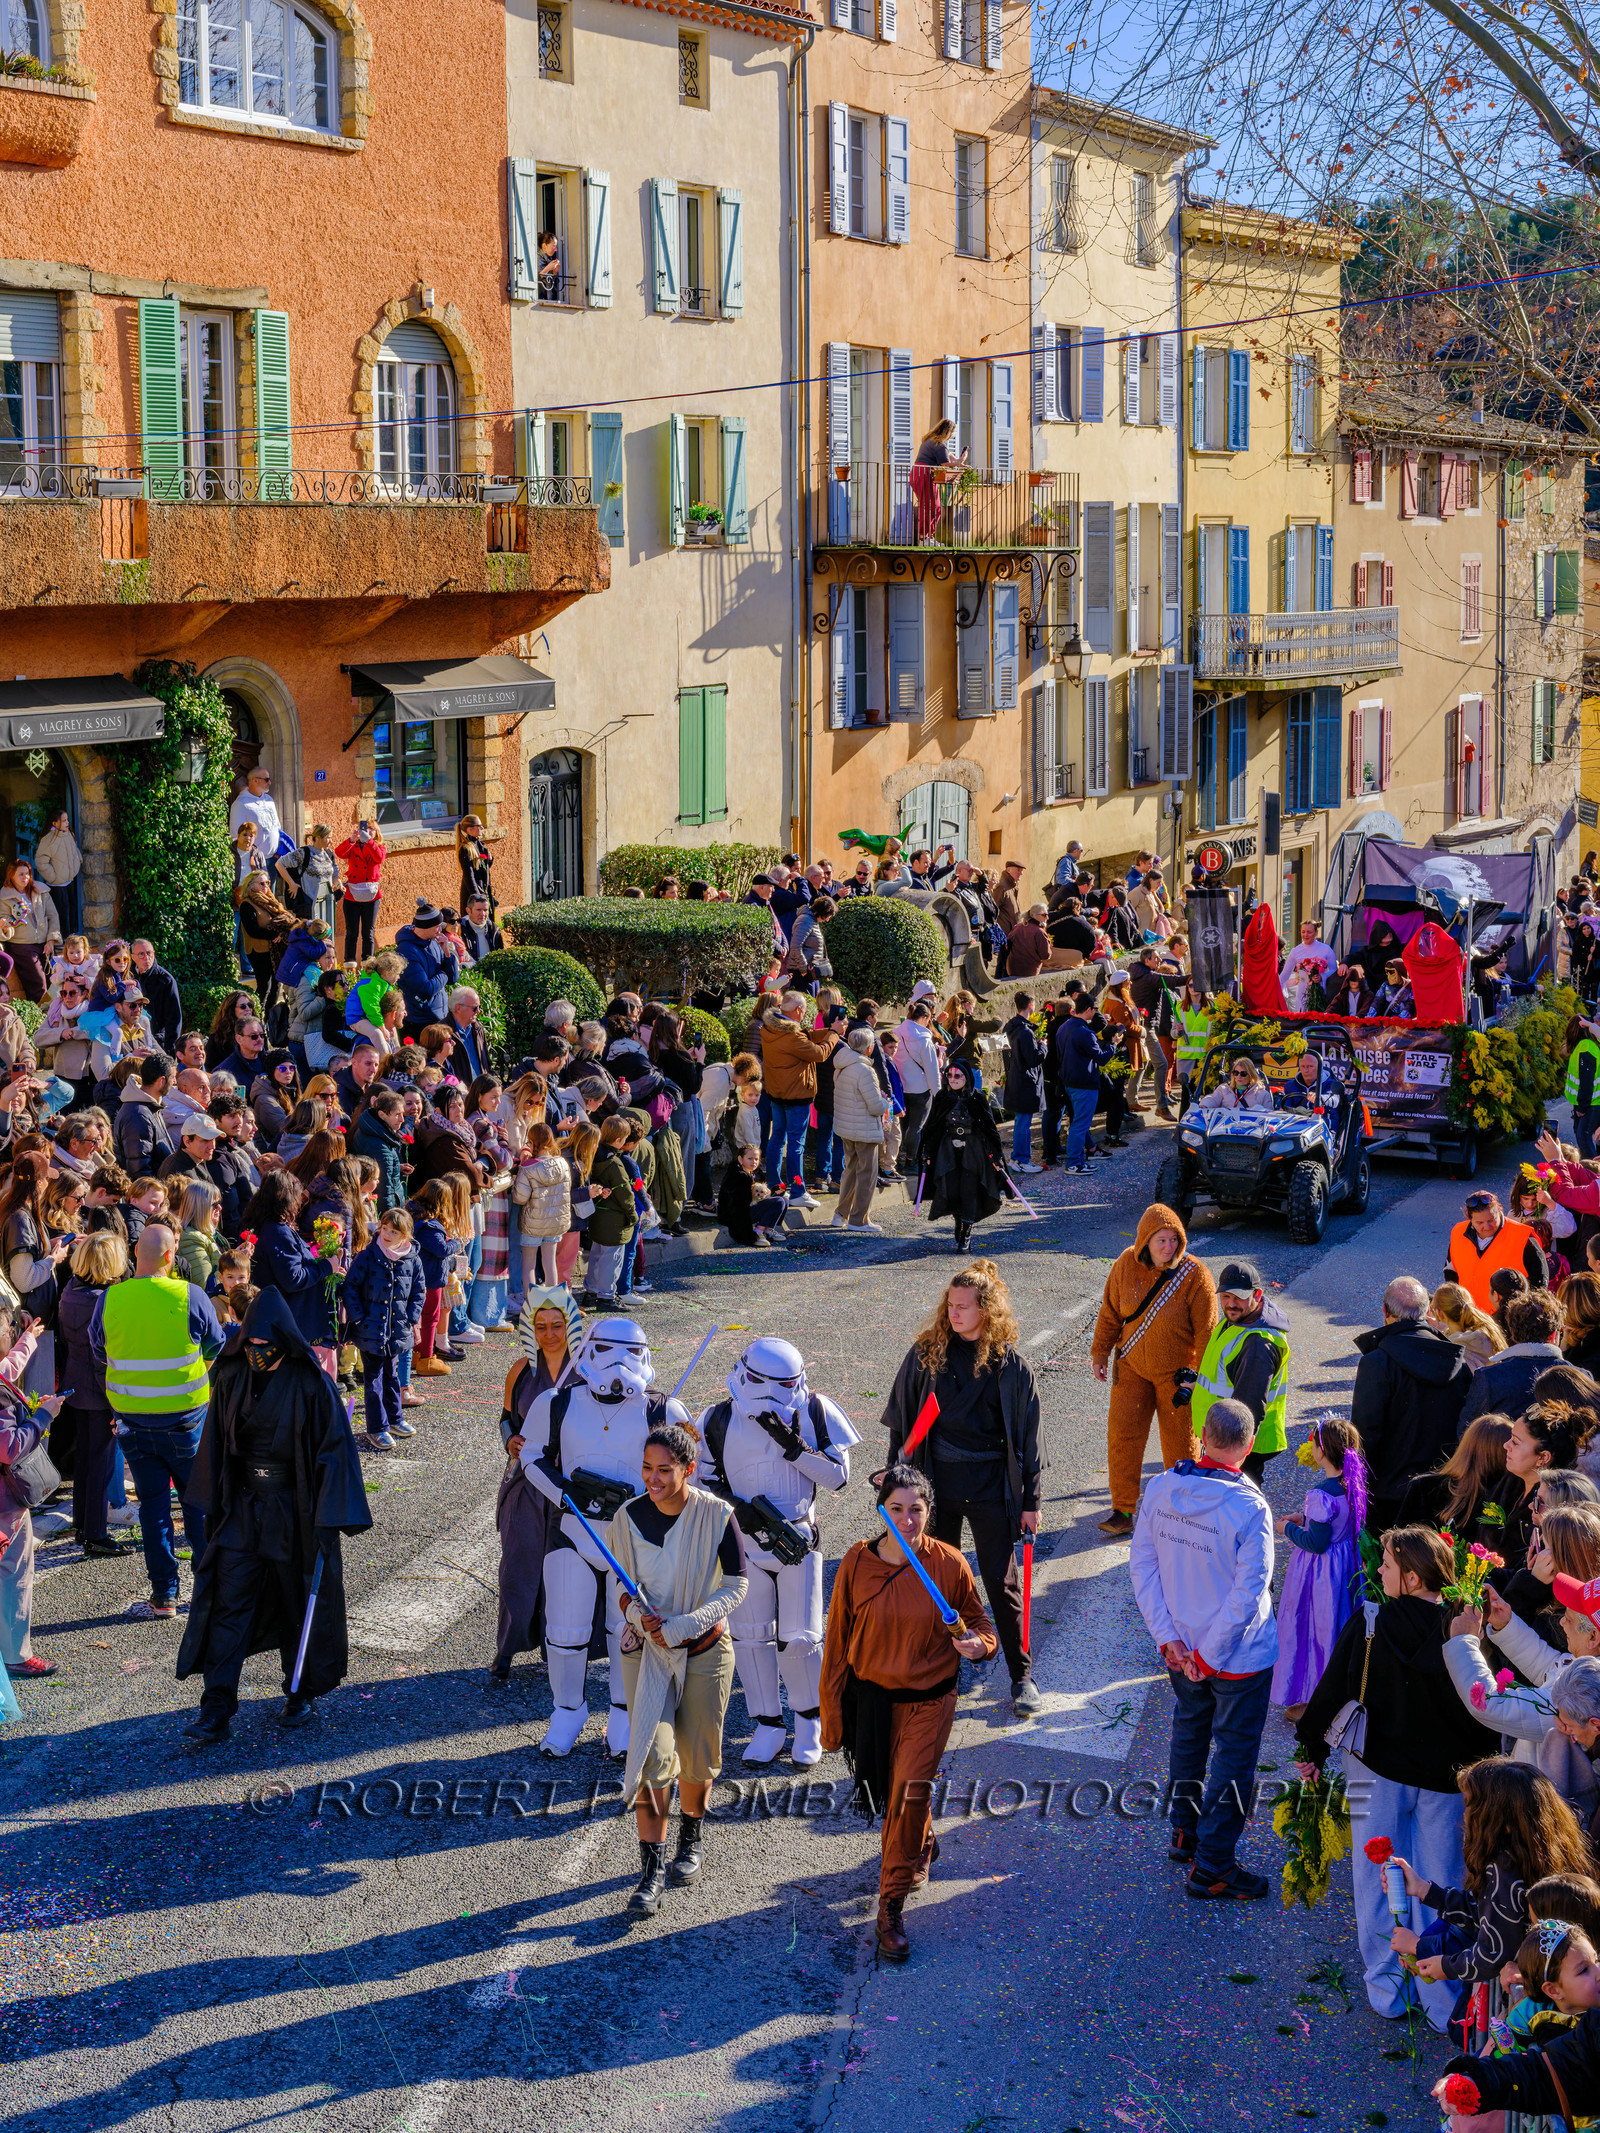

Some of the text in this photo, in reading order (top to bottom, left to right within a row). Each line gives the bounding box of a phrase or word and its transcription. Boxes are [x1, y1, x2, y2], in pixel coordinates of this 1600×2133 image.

[454, 691, 516, 705] MAGREY & SONS
[39, 716, 122, 733] MAGREY & SONS
[317, 772, 324, 780] 27
[1200, 841, 1225, 853] BARNES
[1206, 850, 1219, 869] B
[1321, 1042, 1391, 1065] La Coisée
[1407, 1053, 1437, 1062] STAR
[1407, 1060, 1437, 1069] WARS
[1349, 1065, 1390, 1084] ées
[1156, 1508, 1220, 1535] Réserve Communale
[1159, 1531, 1167, 1539] de
[1192, 1542, 1213, 1554] Civile
